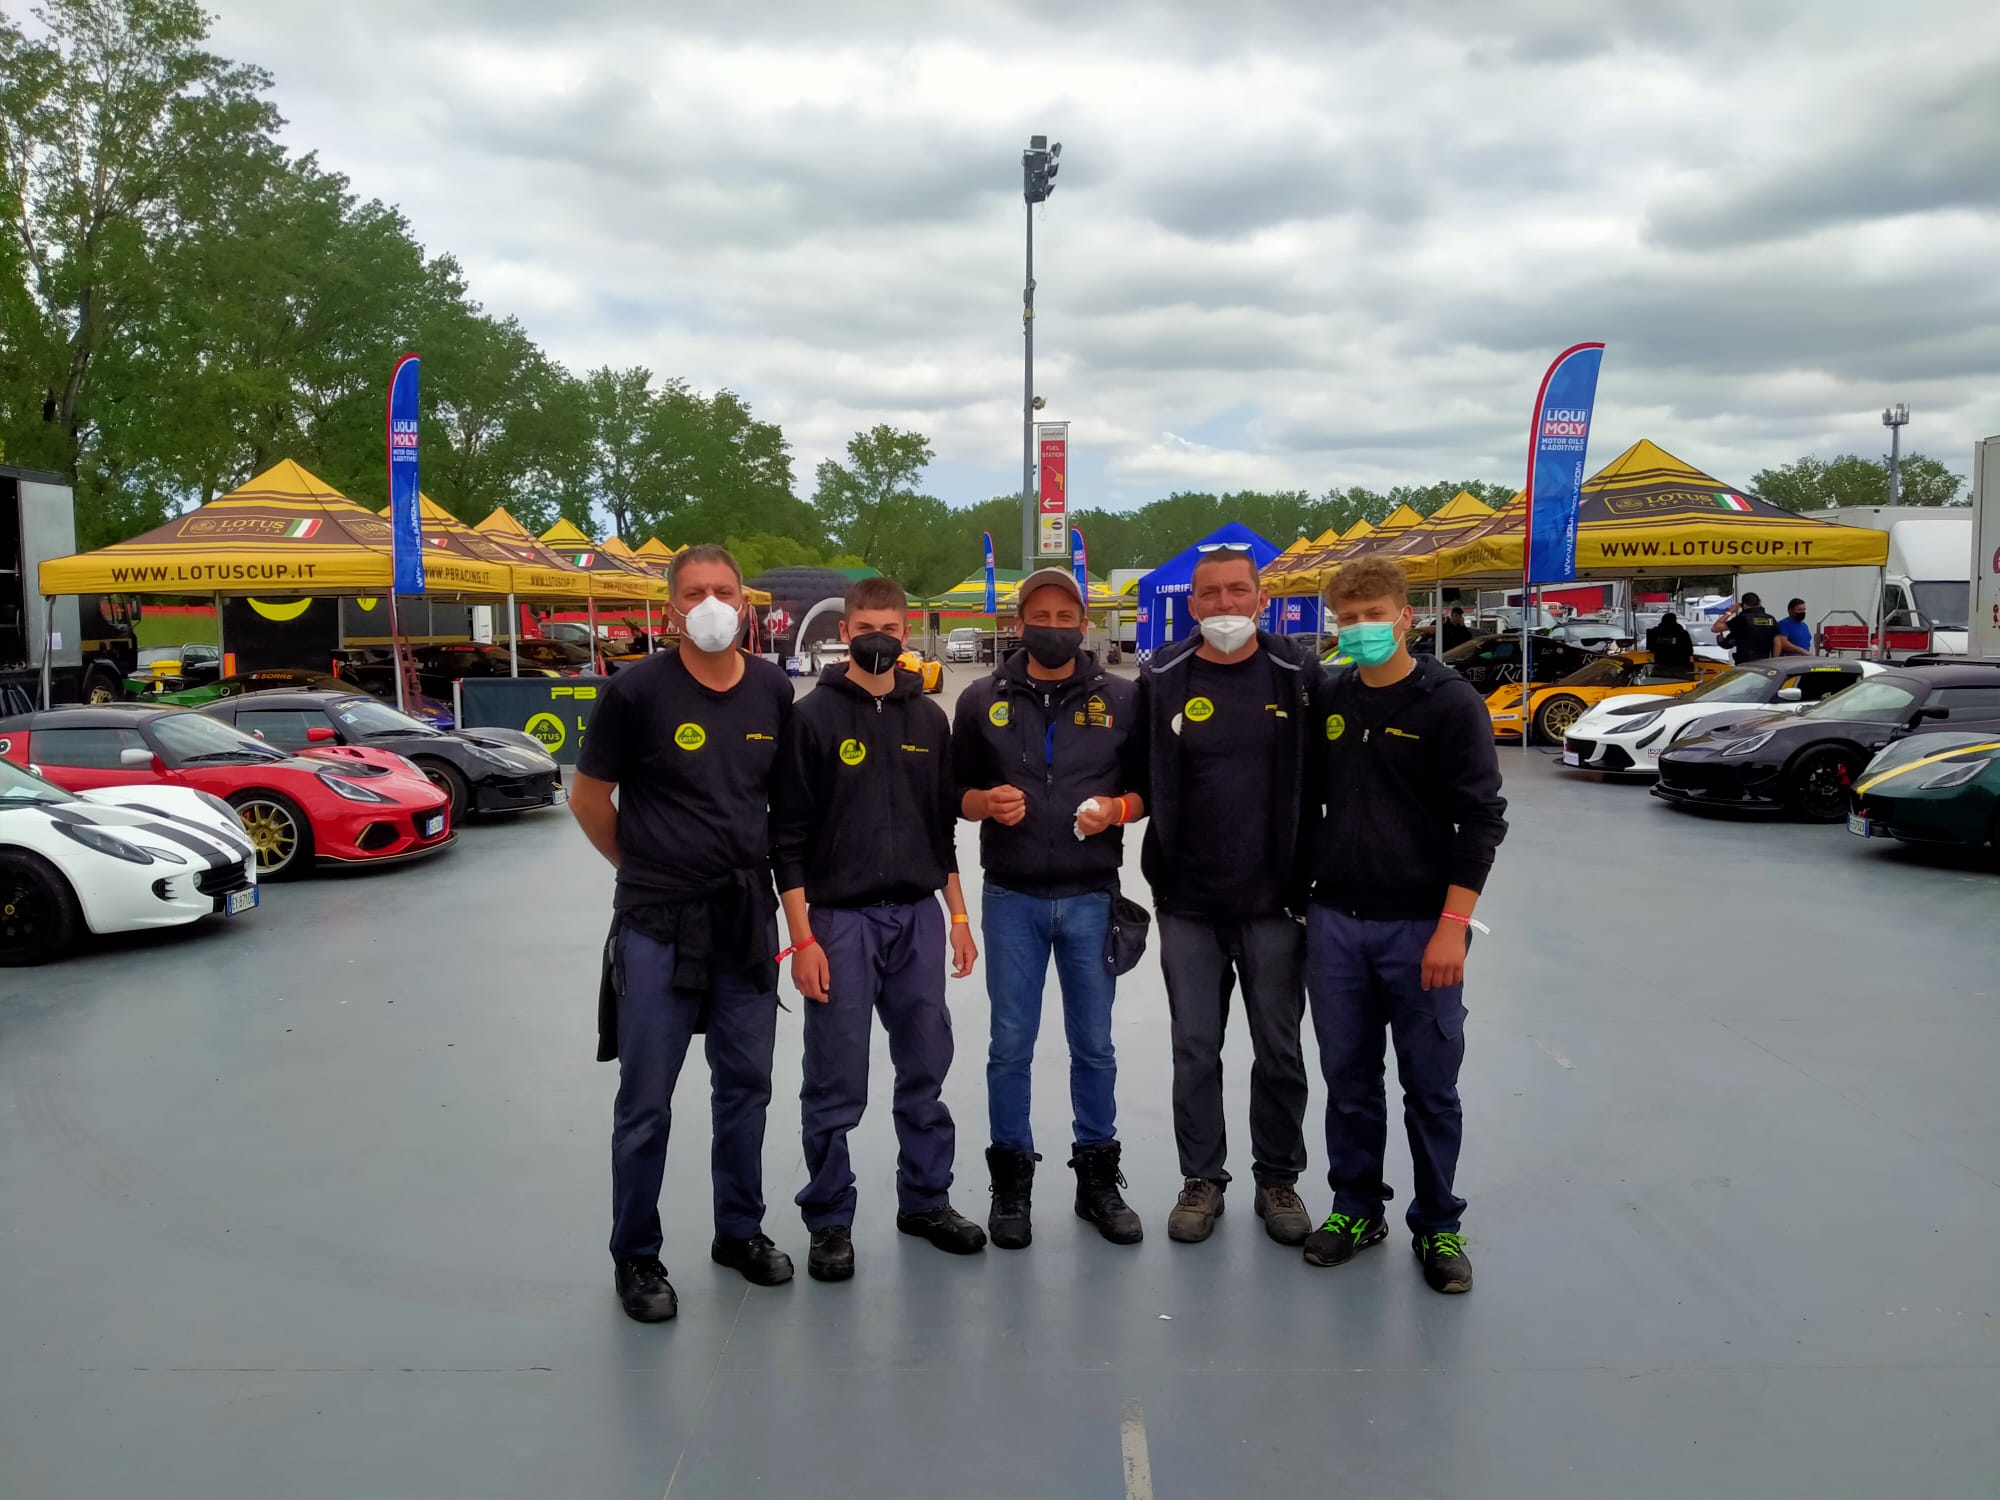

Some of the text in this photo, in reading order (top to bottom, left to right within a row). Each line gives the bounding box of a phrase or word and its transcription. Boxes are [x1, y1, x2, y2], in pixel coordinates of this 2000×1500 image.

[1546, 410, 1586, 422] LIQUI
[393, 421, 417, 433] LIQUI
[1544, 423, 1585, 435] MOLY
[393, 435, 417, 446] MOLY
[1646, 491, 1713, 503] LOTUS
[221, 519, 286, 529] LOTUS
[1601, 541, 1814, 557] WWW.LOTUSCUP.IT
[111, 564, 316, 582] WWW.LOTUSCUP.IT
[551, 686, 597, 700] PB
